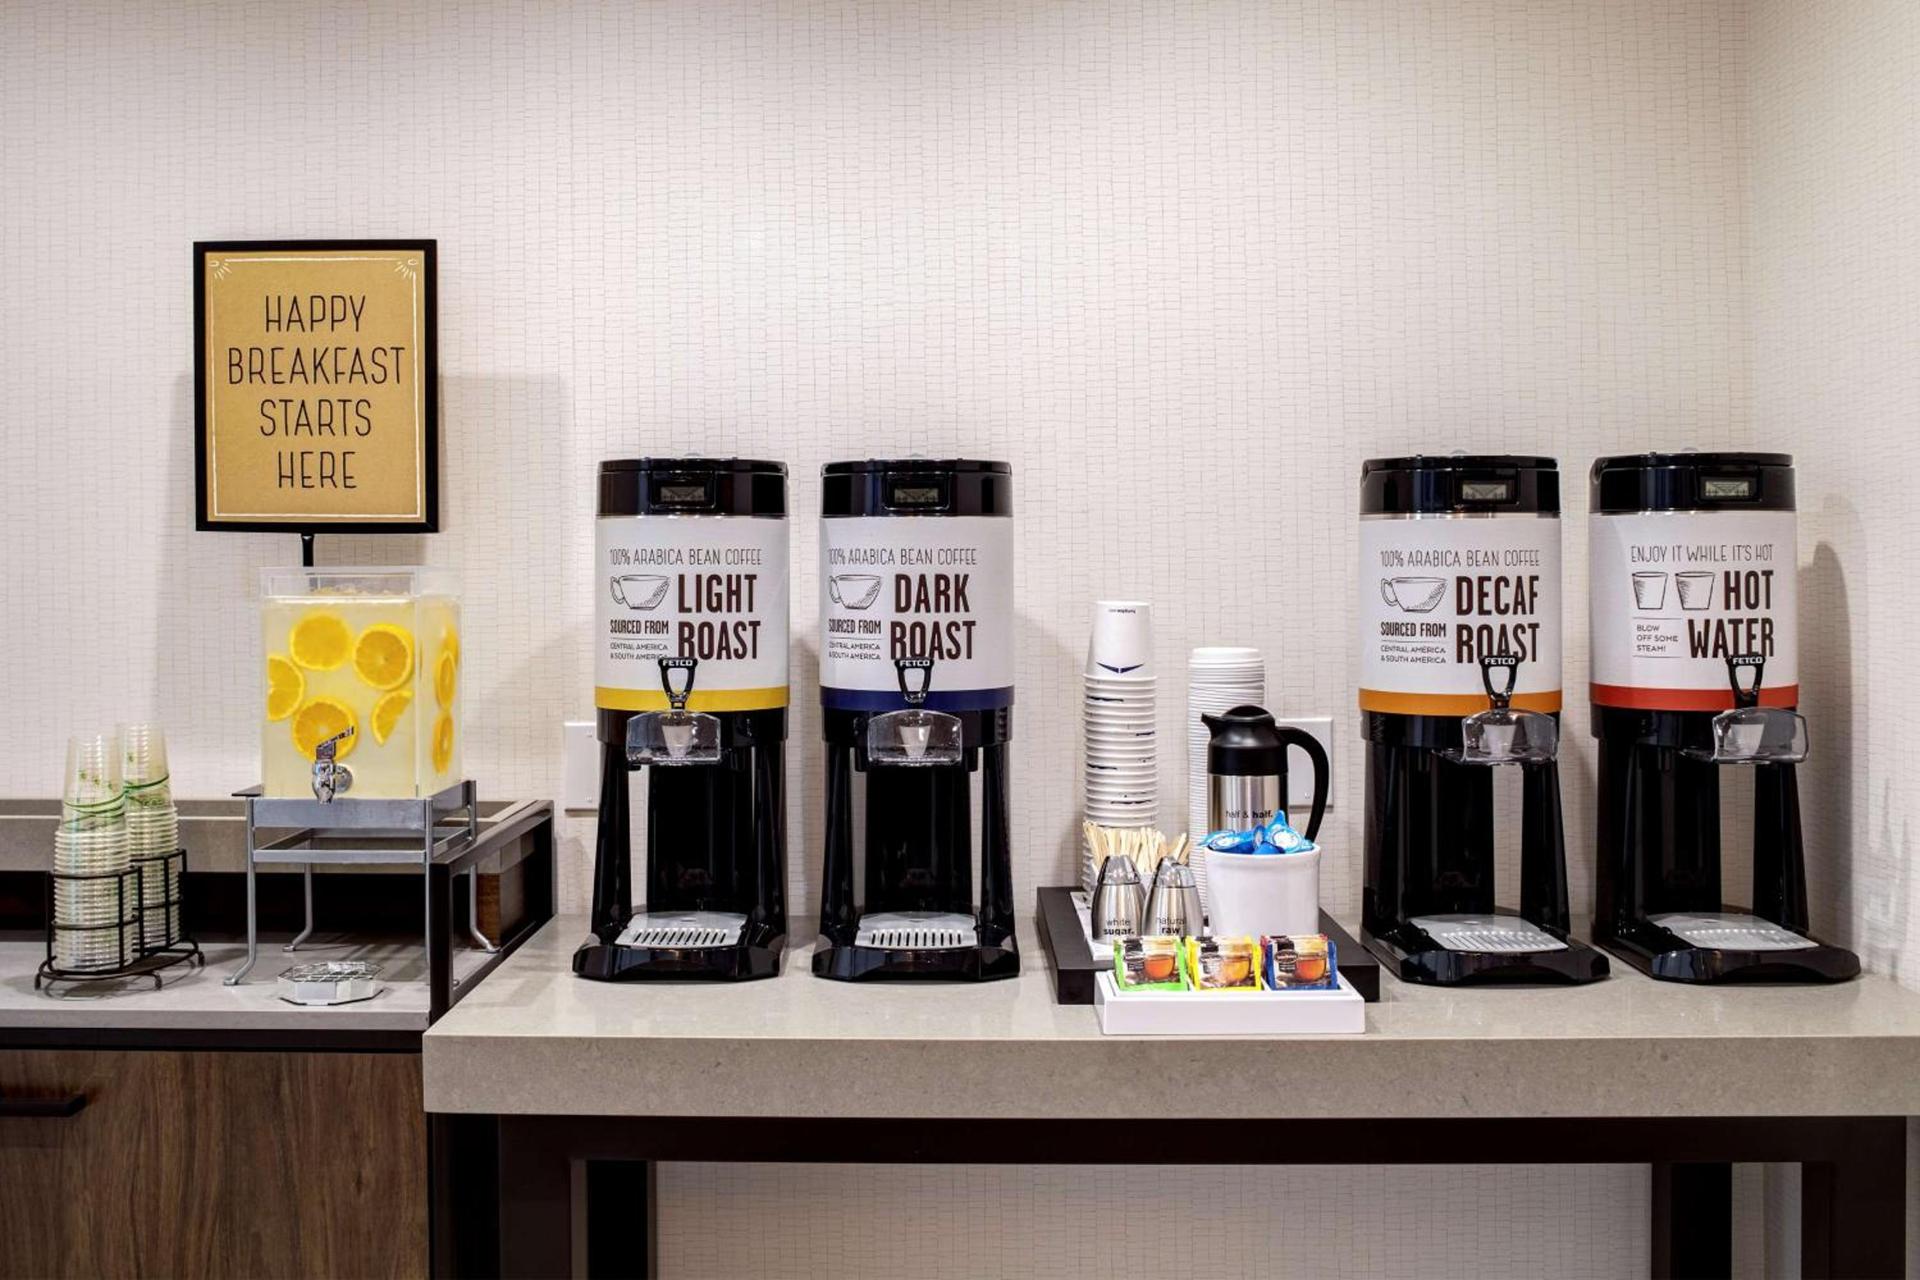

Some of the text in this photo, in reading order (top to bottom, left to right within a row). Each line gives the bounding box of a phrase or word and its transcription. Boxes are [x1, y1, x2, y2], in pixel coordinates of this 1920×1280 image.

[266, 295, 365, 332] HAPPY
[228, 347, 405, 384] BREAKFAST
[260, 399, 371, 437] STARTS
[278, 451, 358, 489] HERE
[610, 548, 762, 565] 100% ARABICA BEAN COFFEE
[848, 548, 895, 565] ARABICA
[900, 548, 933, 565] BEAN
[938, 548, 978, 565] COFFEE
[1381, 549, 1540, 567] 100% ARABICA BEAN COFFEE
[1631, 544, 1774, 563] ENJOY IT WHILE IT'S HOT
[678, 574, 757, 613] LIGHT
[895, 573, 970, 613] DARK
[1456, 575, 1539, 616] DECAF
[1724, 570, 1774, 610] HOT
[610, 619, 669, 634] SOURCED FROM
[828, 618, 882, 634] SOURCED FROM
[1381, 621, 1446, 637] SOURCED FROM
[1636, 624, 1660, 632] BLOW
[678, 620, 761, 660] ROAST
[890, 620, 976, 660] ROAST
[1456, 623, 1540, 664] ROAST
[1636, 634, 1679, 642] OFF SOME
[1687, 618, 1774, 659] WATER
[636, 643, 668, 651] AMERICA
[1381, 645, 1446, 654] CENTRAL AMERICA
[1636, 644, 1666, 652] STEAM!
[662, 659, 693, 667] FETCO
[1410, 656, 1446, 664] AMERICA
[1732, 657, 1763, 665] FETCO
[1225, 809, 1240, 818] half
[1252, 809, 1273, 819] half.
[1107, 917, 1131, 926] white
[1156, 916, 1186, 926] natural
[1103, 927, 1135, 936] sugar.
[1161, 927, 1181, 935] raw
